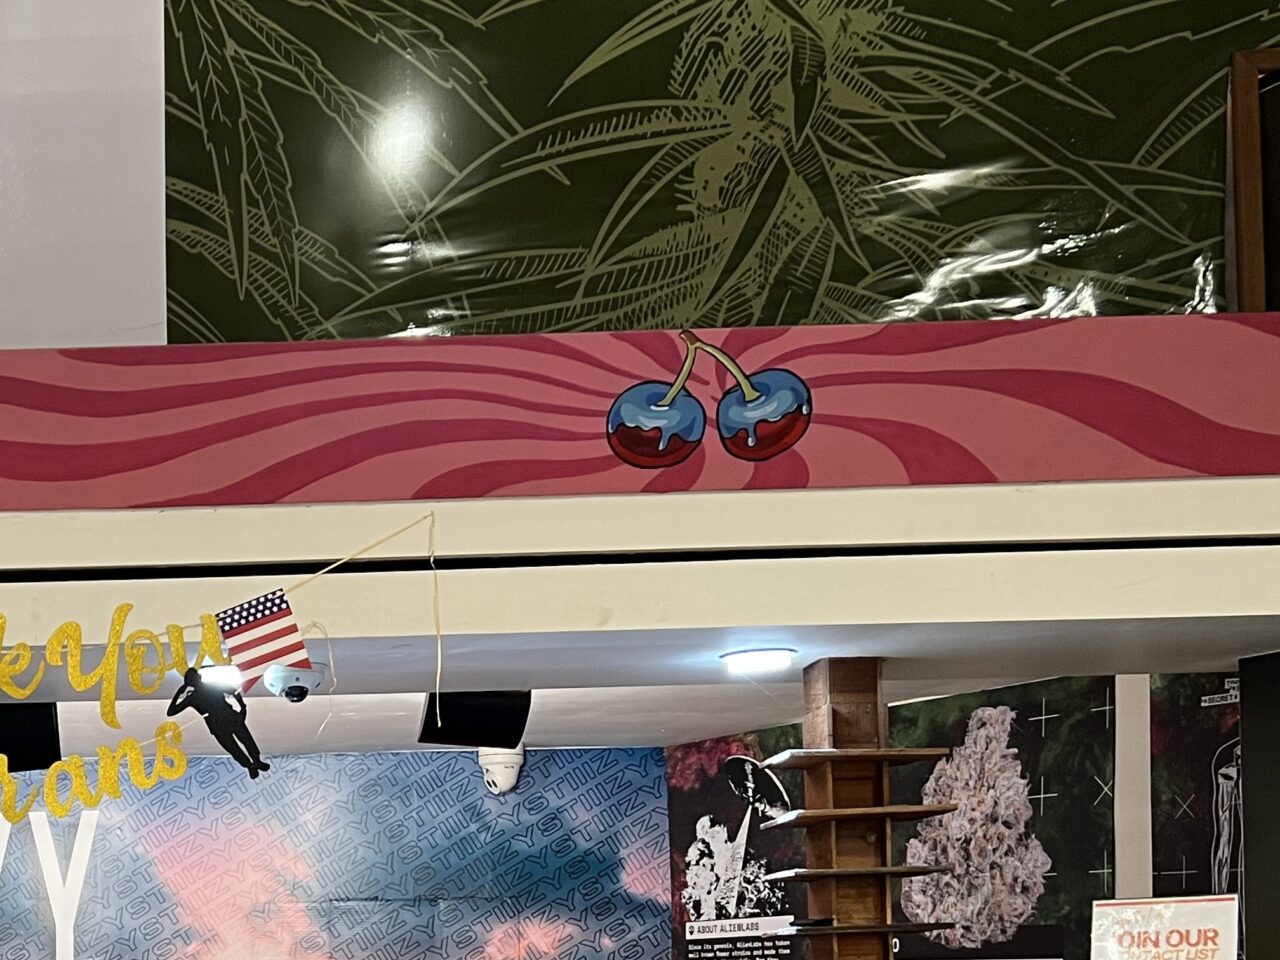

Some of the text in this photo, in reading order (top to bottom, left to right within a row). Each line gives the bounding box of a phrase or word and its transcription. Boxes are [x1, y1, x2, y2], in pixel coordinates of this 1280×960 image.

[45, 602, 232, 729] You
[697, 922, 760, 934] ABOUT ALIENLABS
[1116, 928, 1220, 949] OIN OUR
[1122, 948, 1220, 960] ONTACT LIST
